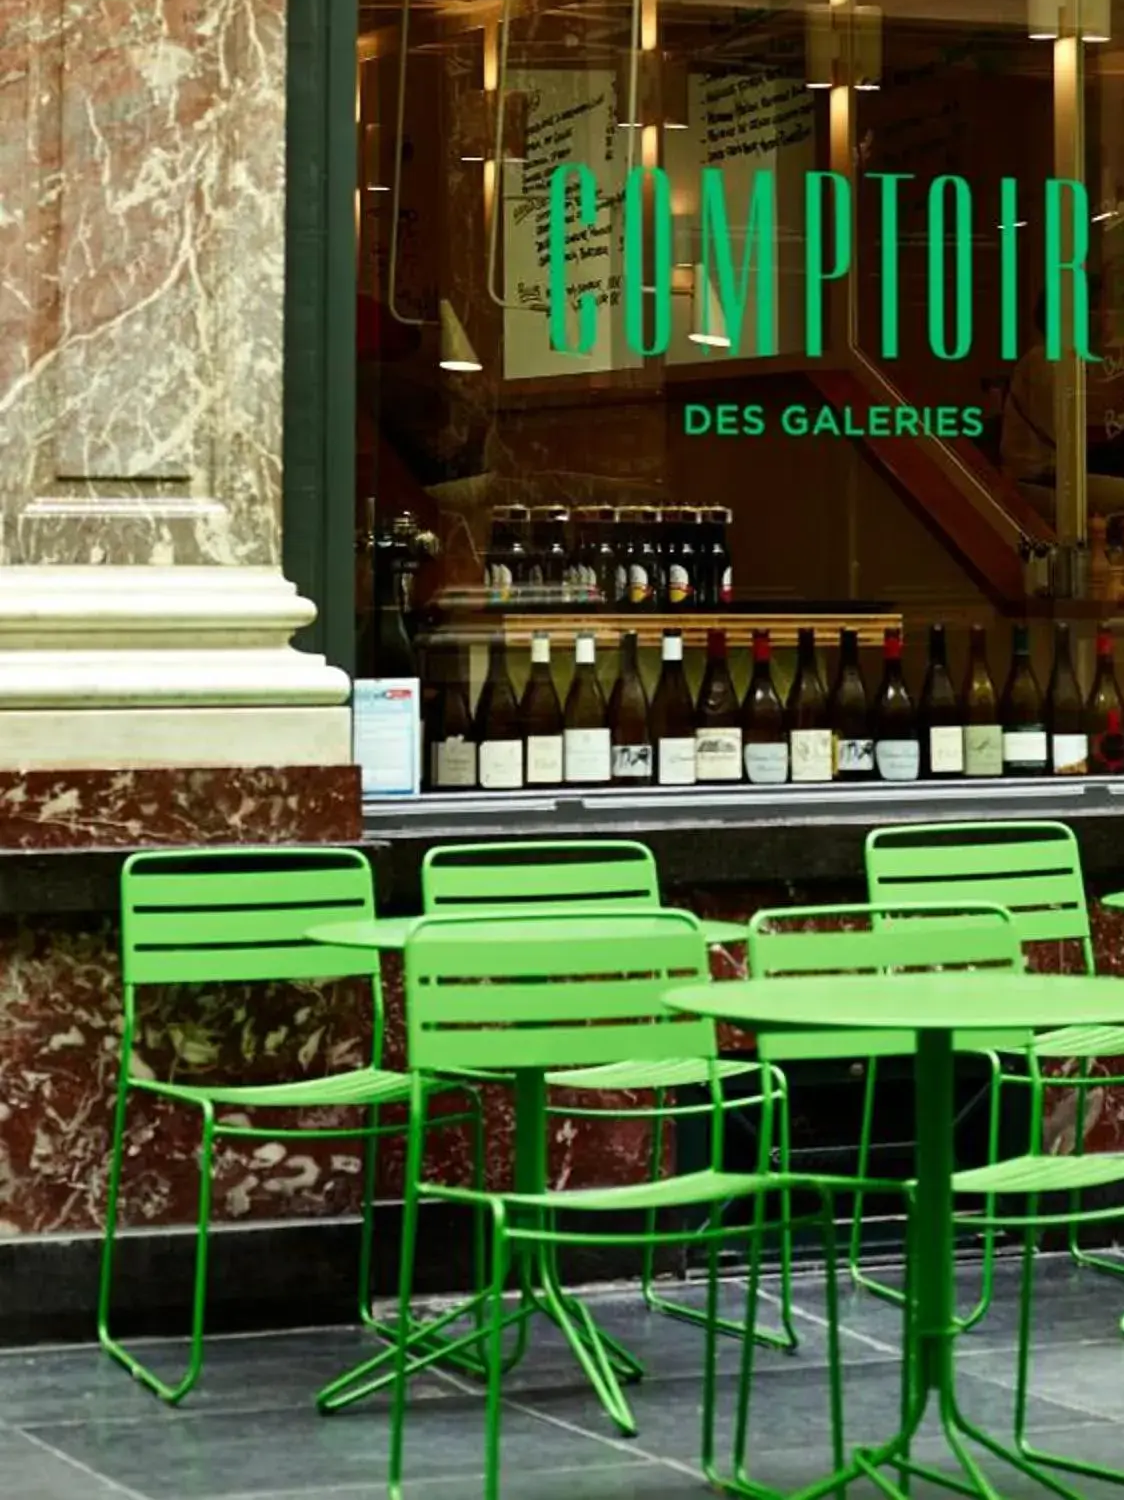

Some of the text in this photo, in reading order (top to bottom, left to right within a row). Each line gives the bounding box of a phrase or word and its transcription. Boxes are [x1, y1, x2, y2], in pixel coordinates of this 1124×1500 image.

[549, 164, 1102, 362] COMPTOIR
[685, 405, 983, 437] DES GALERIES
